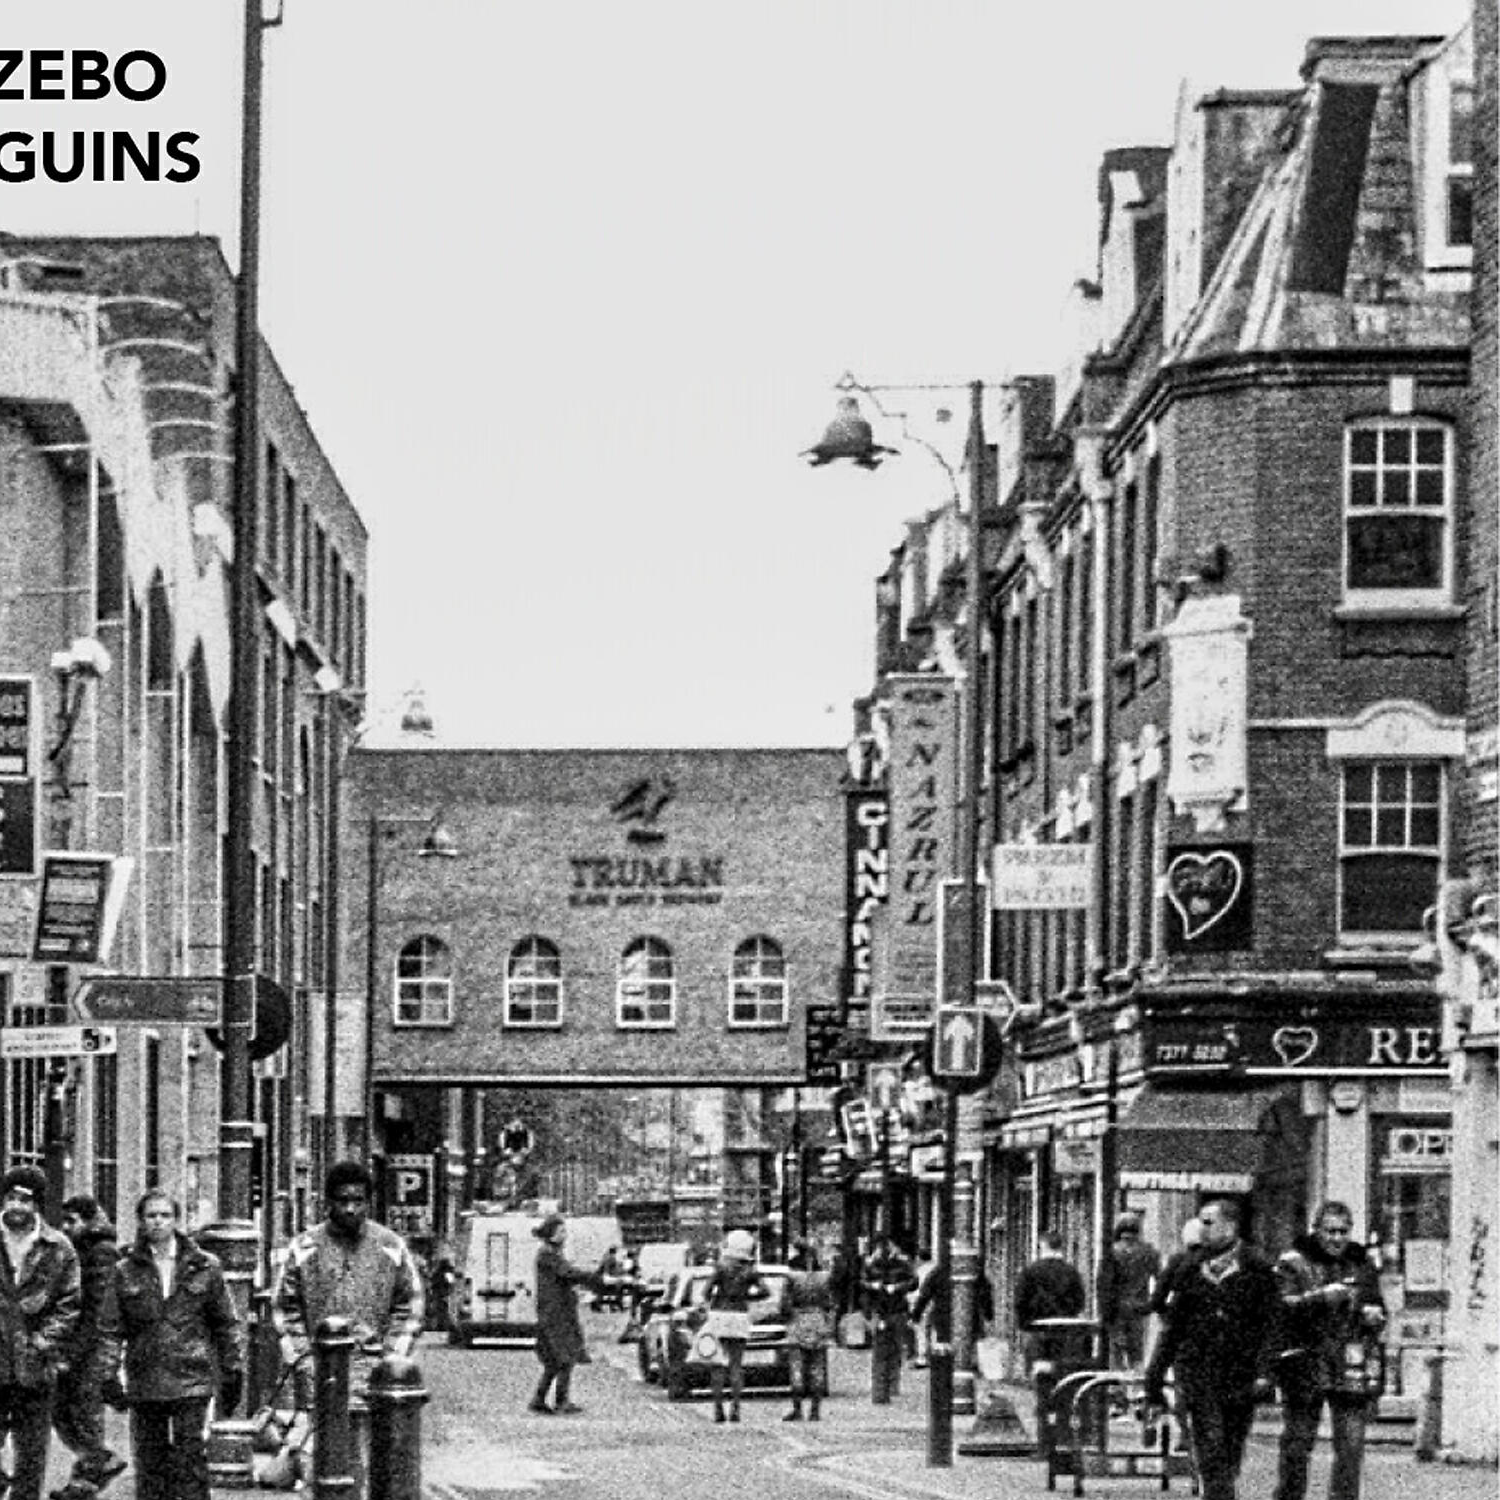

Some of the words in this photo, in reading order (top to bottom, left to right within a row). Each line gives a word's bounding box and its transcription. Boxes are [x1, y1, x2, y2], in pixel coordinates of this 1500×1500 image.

[904, 742, 941, 926] NAZRUL
[568, 855, 724, 888] TRUMAN
[1368, 1026, 1449, 1065] RE
